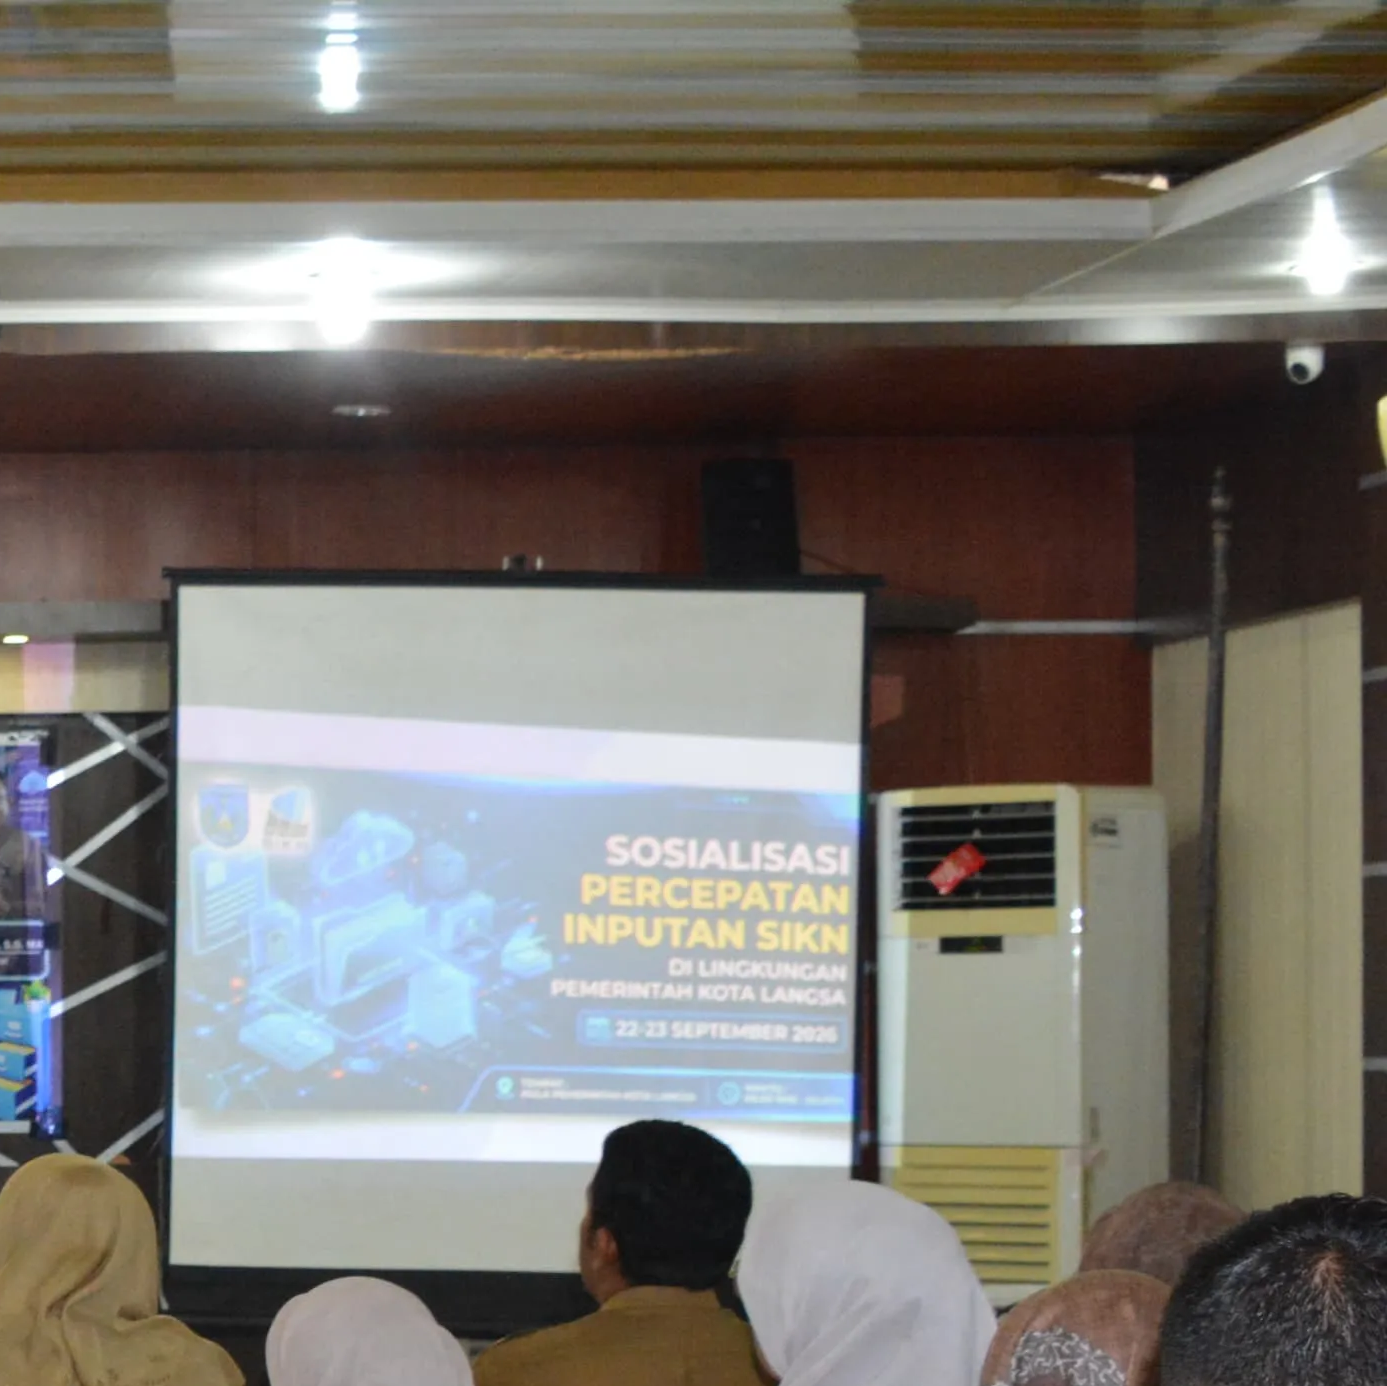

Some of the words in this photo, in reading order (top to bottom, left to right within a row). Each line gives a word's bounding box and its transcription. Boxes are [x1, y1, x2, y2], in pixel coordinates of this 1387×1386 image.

[605, 834, 851, 876] SOSIALISASI
[580, 873, 850, 915] PERCEPATAN
[563, 913, 746, 949] INPUTAN
[756, 920, 849, 954] SIKN
[668, 957, 693, 977] DI
[698, 958, 847, 982] LINGKUNGAN
[550, 979, 694, 1000] PEMERINTAH
[697, 982, 755, 1002] KOTA
[760, 985, 845, 1006] LANGSA
[615, 1019, 667, 1038] 22-23
[671, 1021, 787, 1041] SEPTEMBER
